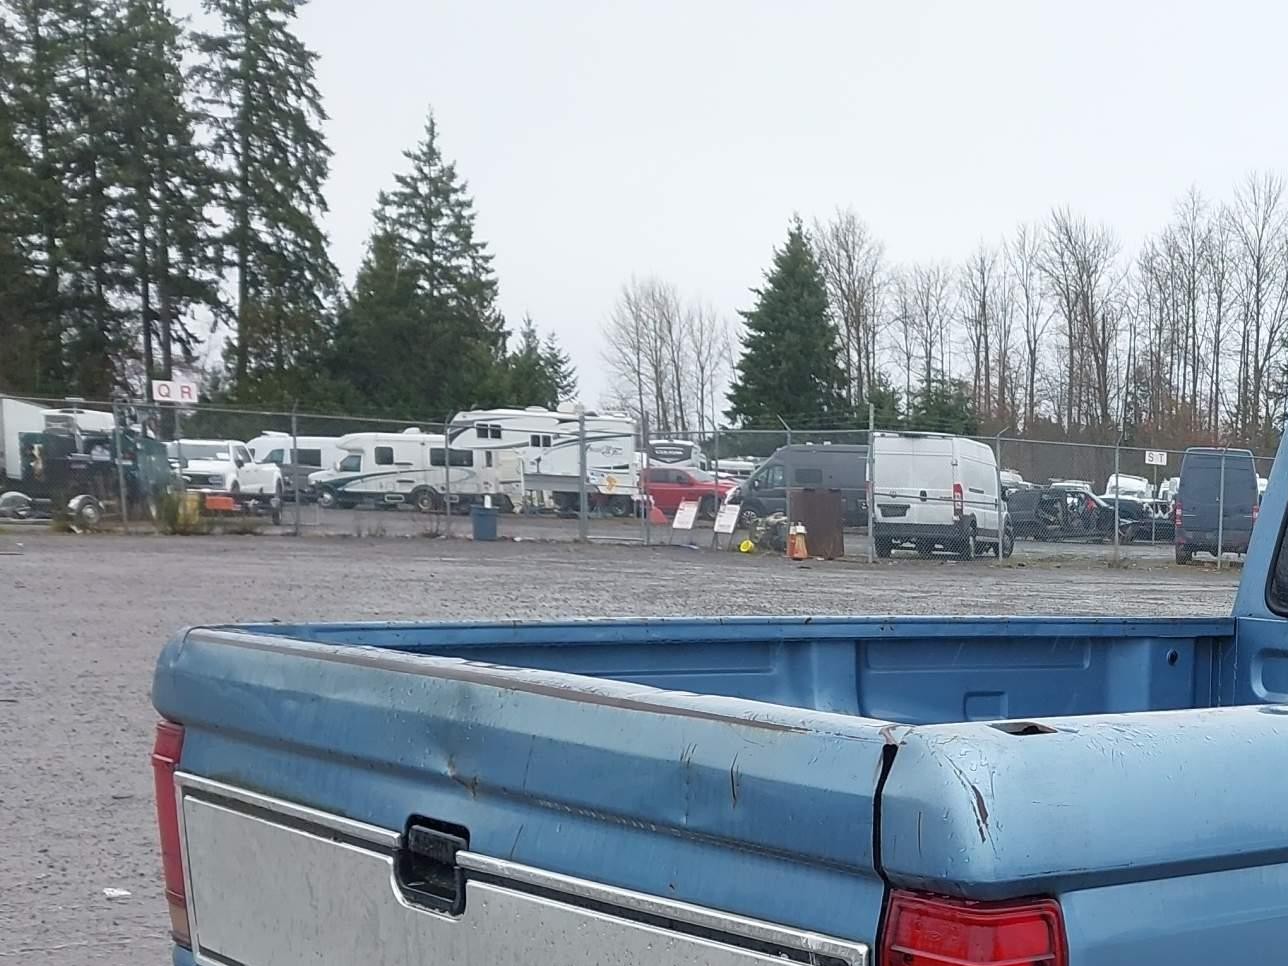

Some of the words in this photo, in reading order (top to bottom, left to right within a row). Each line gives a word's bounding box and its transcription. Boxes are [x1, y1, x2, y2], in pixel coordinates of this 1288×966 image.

[158, 383, 171, 398] Q
[180, 385, 192, 400] R
[1148, 452, 1154, 463] S
[1159, 453, 1165, 463] T
